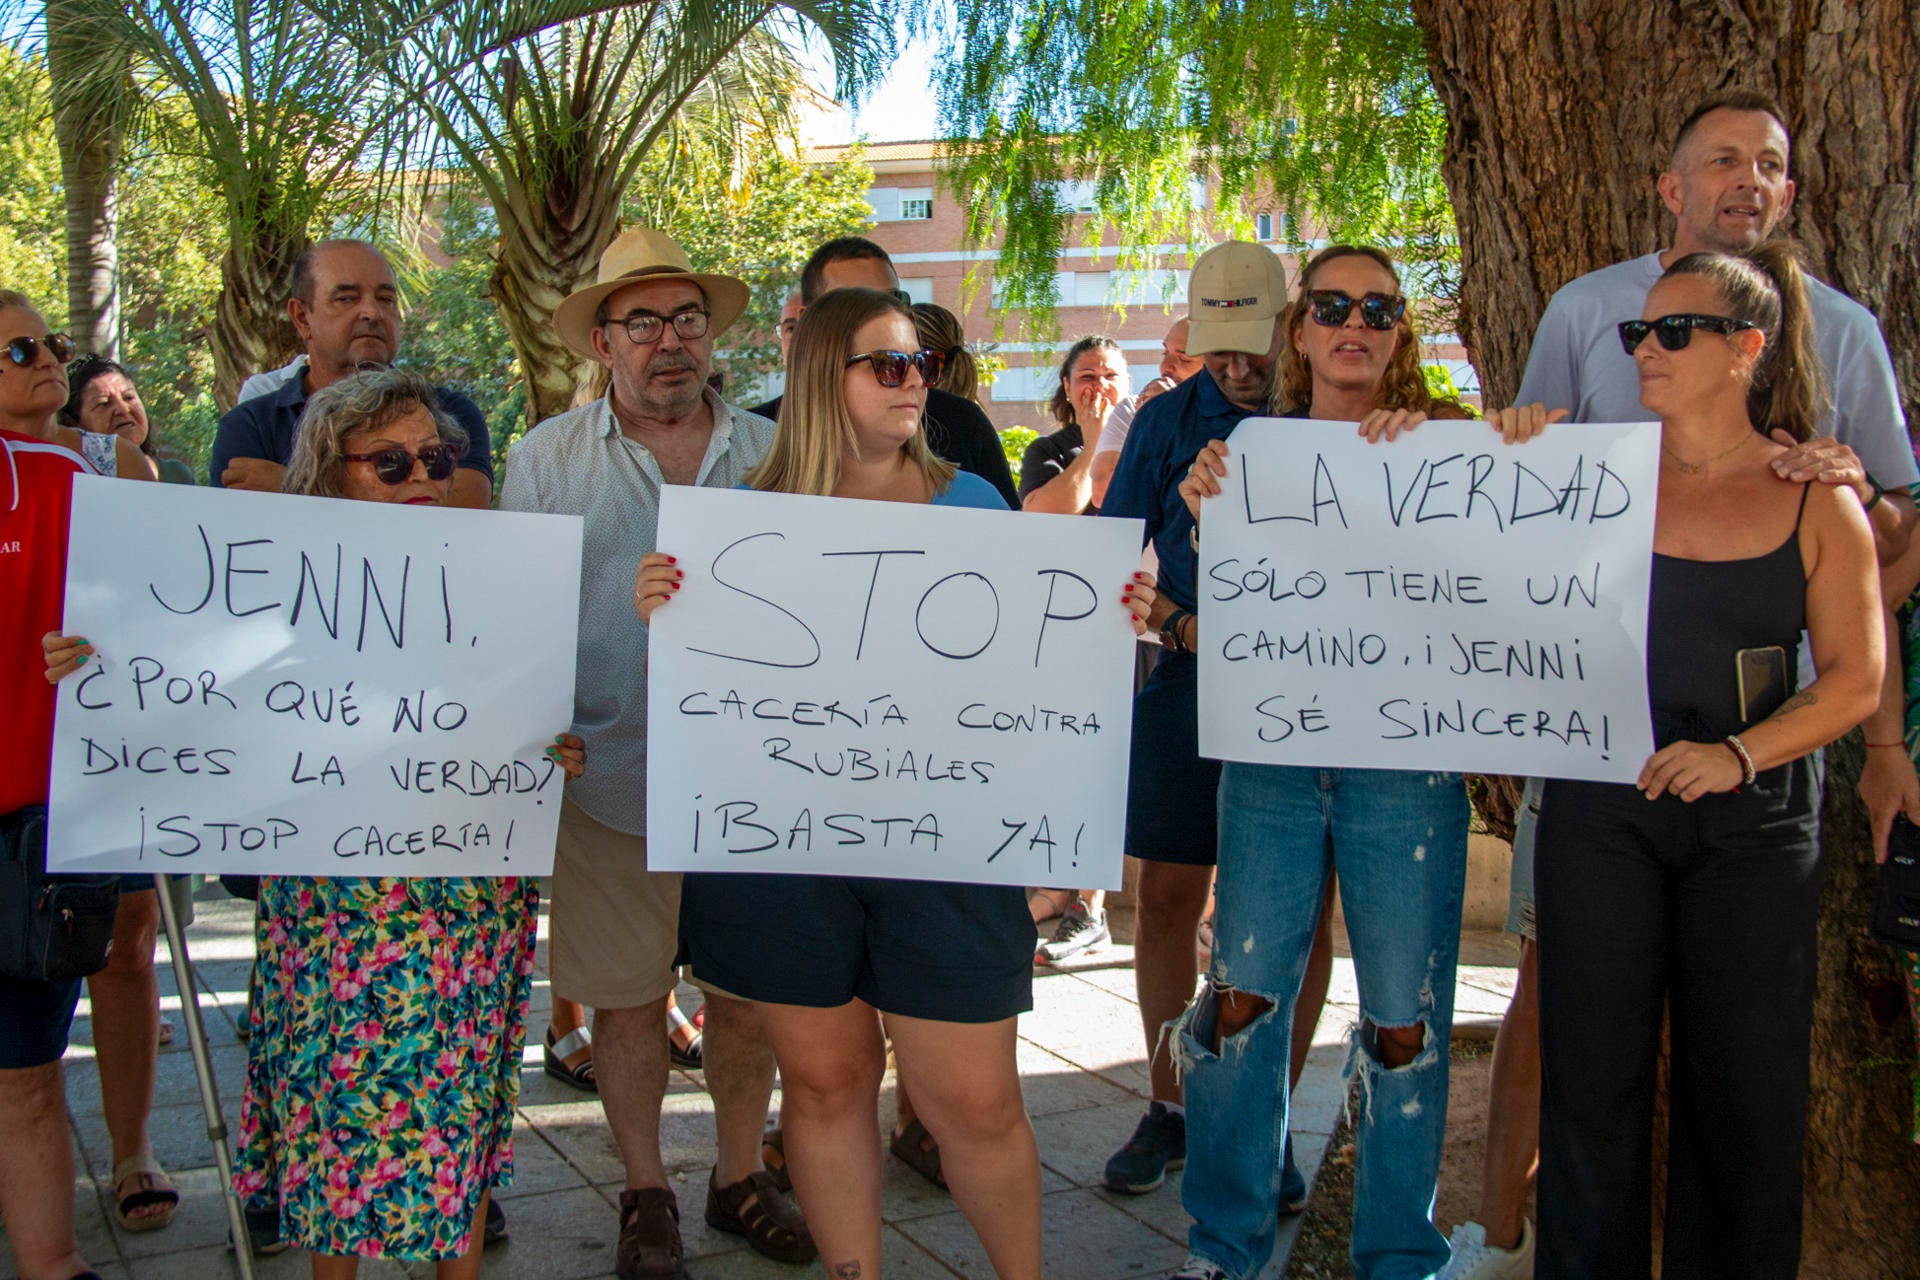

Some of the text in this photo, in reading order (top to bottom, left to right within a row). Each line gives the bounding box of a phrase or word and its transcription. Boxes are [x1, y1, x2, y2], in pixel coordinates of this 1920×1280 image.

[1240, 452, 1631, 534] LA VERDAD
[685, 531, 1099, 669] STOP
[1208, 557, 1327, 603] SÓLO
[1526, 561, 1601, 609] UN
[75, 654, 468, 734] ¿POR QUÉ NO
[678, 688, 1102, 736] CACERÍA CONTRA
[1255, 693, 1331, 744] SÉ
[290, 751, 346, 787] LA
[389, 756, 556, 806] VERDAD?
[138, 806, 300, 861] ¡STOP
[693, 793, 1085, 874] ¡BASTA YA!
